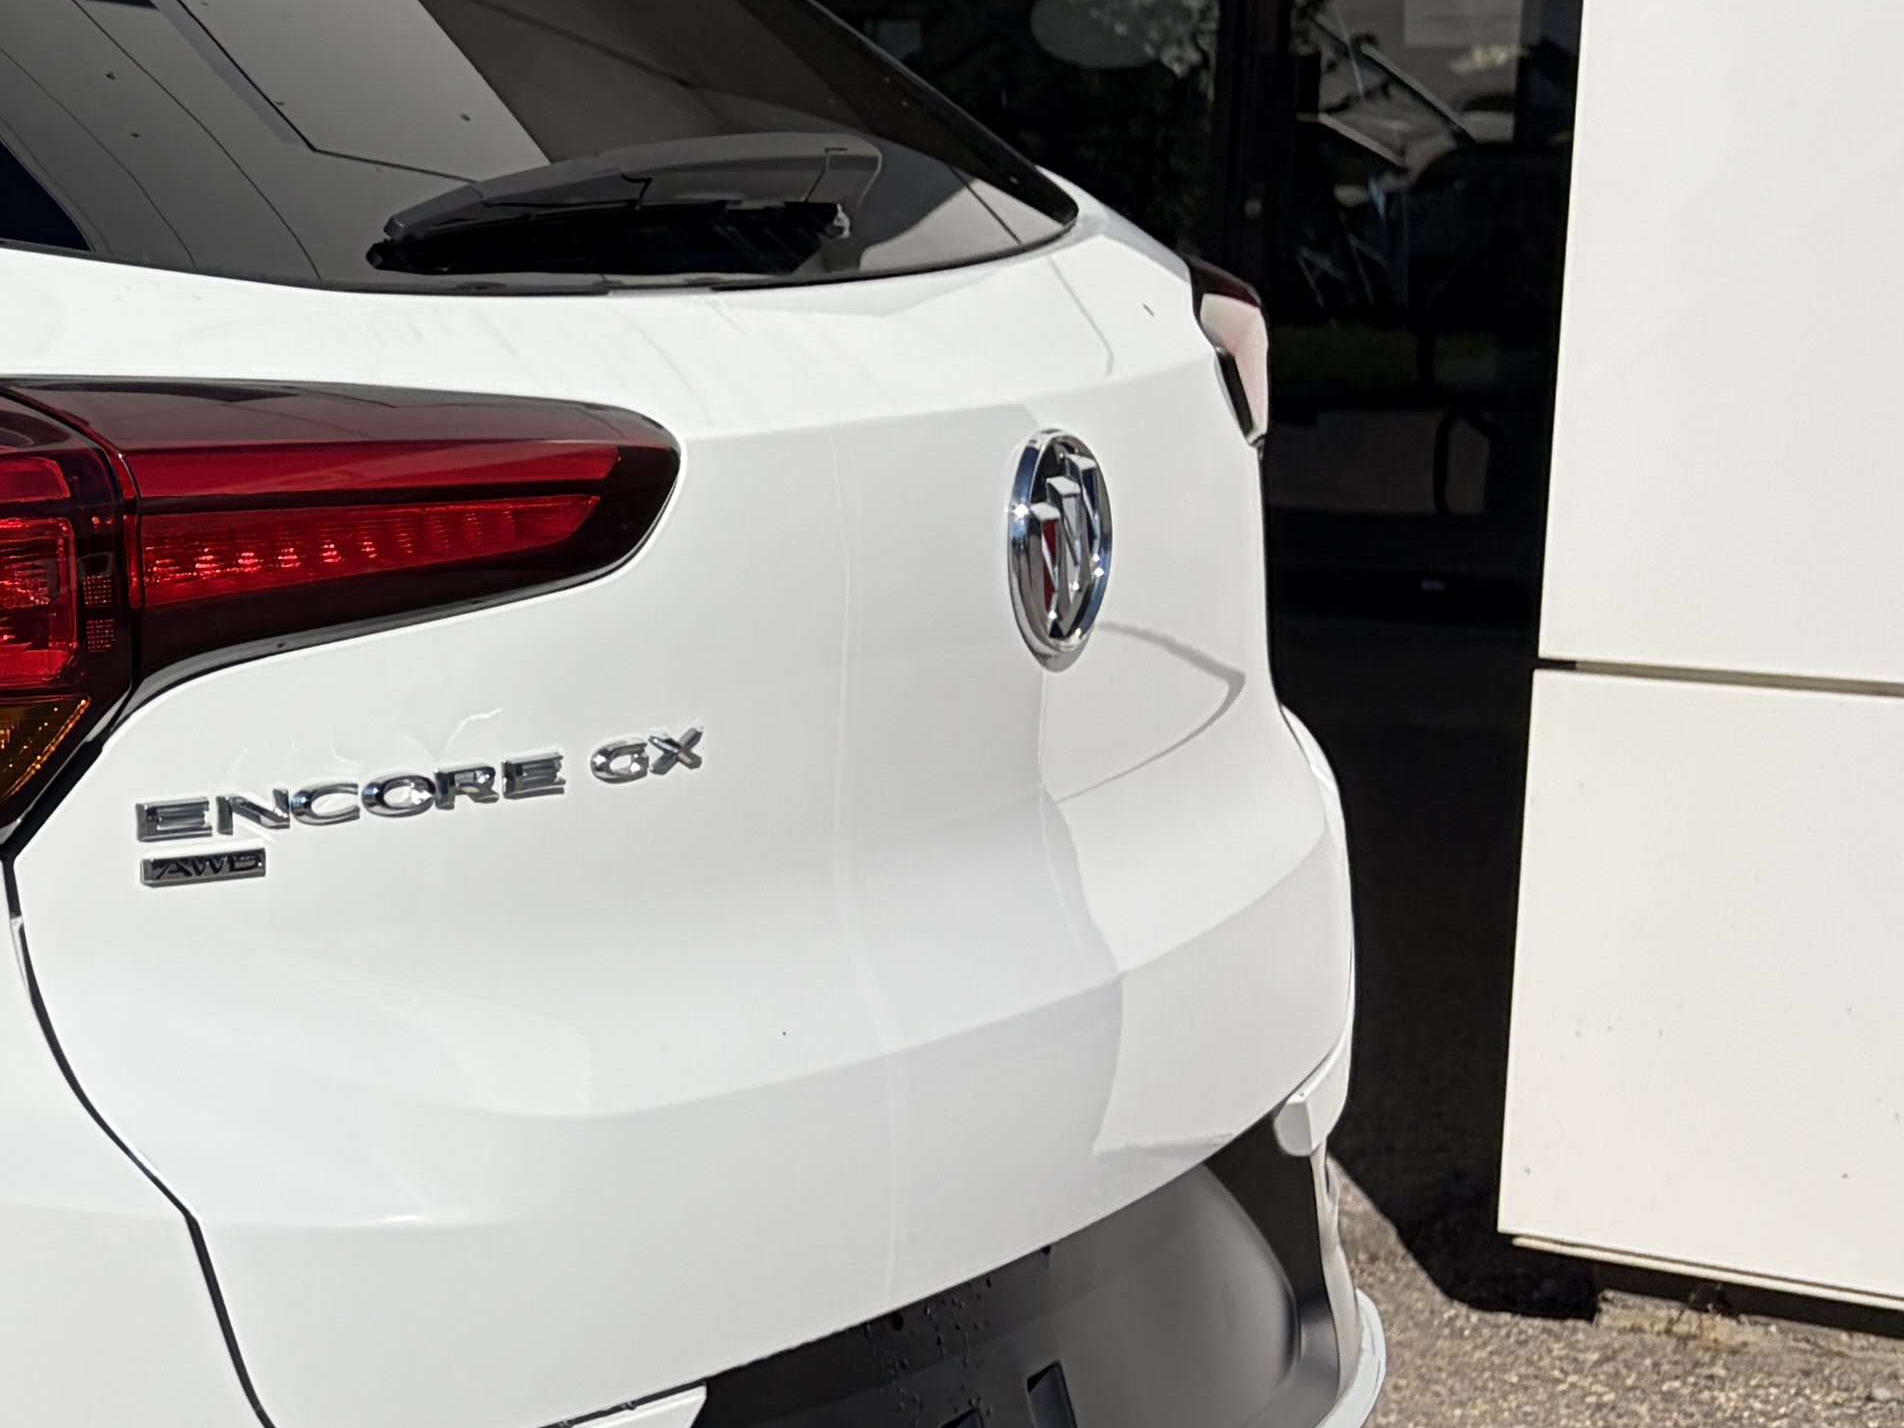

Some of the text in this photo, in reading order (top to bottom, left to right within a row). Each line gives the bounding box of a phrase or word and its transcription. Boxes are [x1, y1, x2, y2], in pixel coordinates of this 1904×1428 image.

[135, 725, 705, 843] ENCORE GX
[154, 850, 265, 882] AWD
